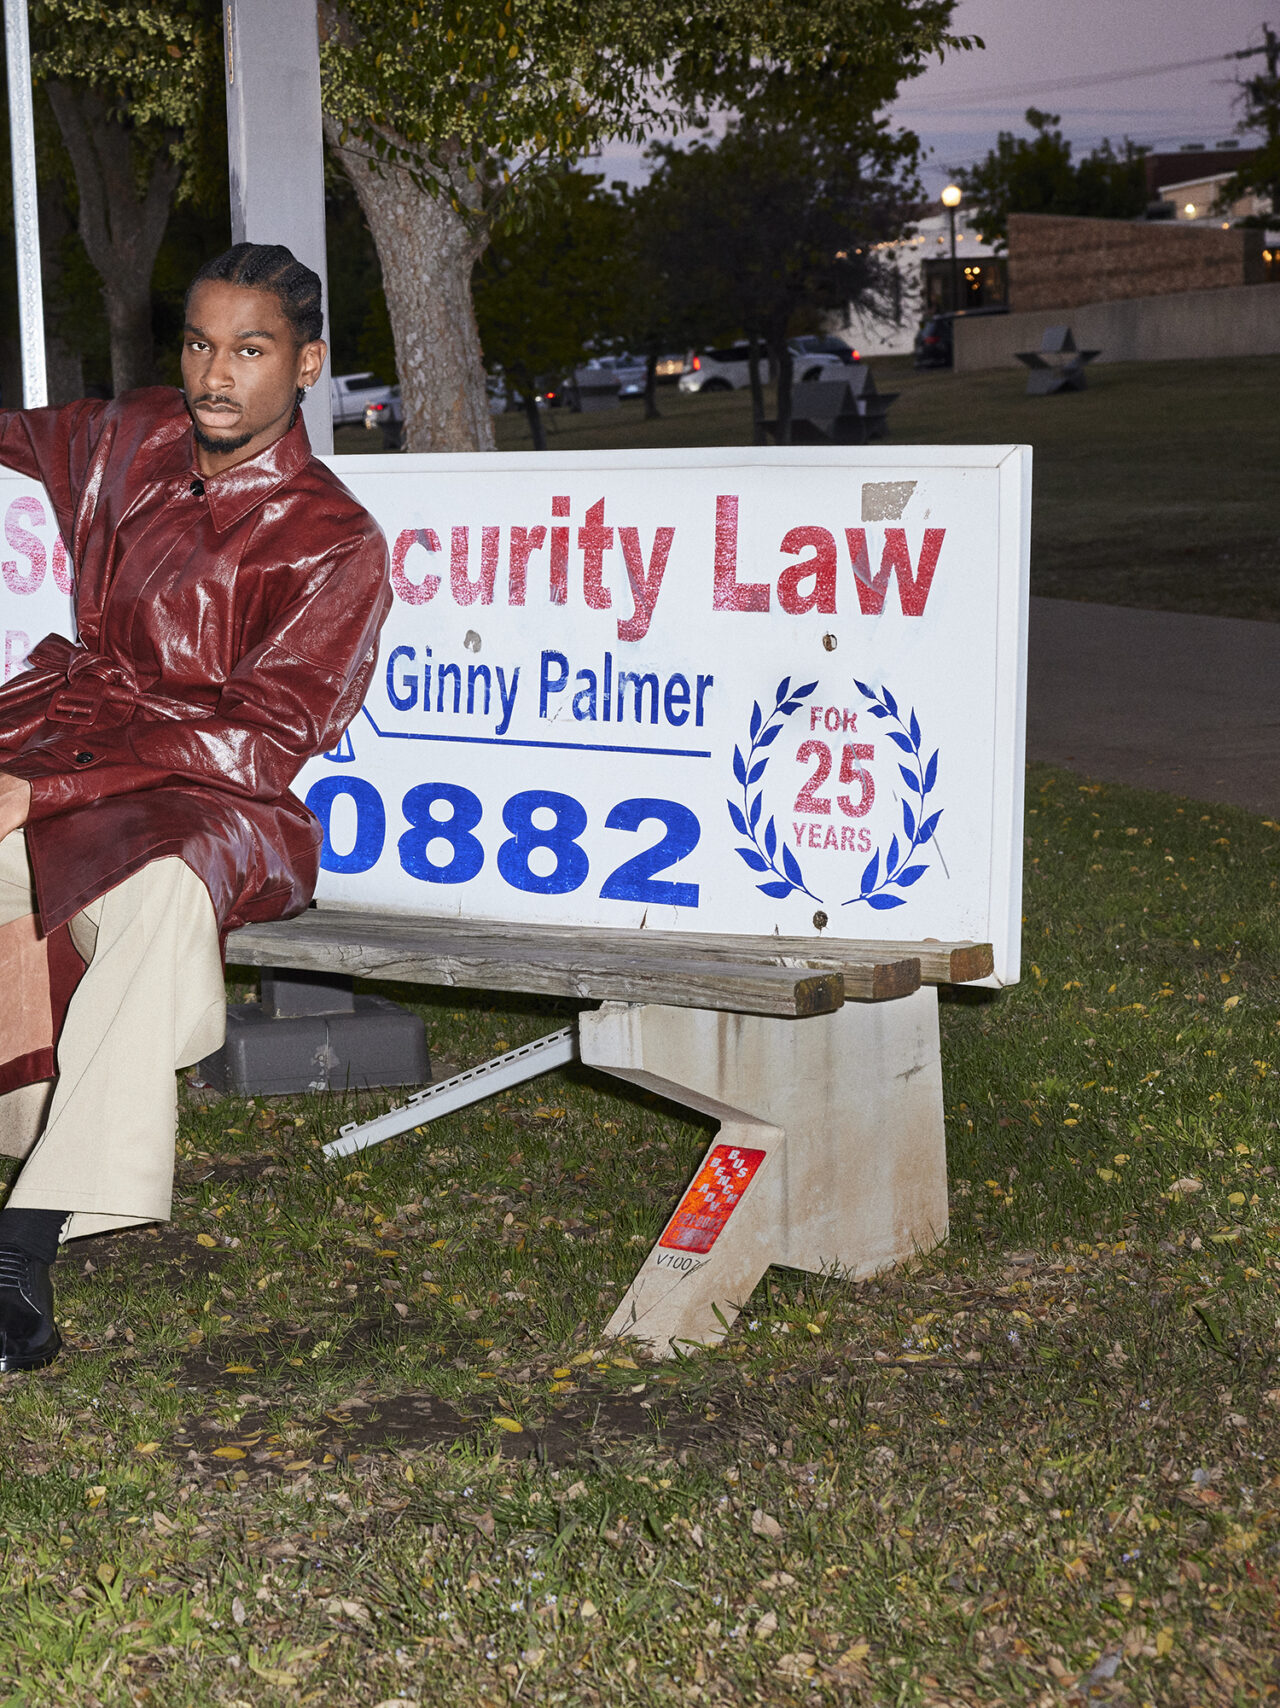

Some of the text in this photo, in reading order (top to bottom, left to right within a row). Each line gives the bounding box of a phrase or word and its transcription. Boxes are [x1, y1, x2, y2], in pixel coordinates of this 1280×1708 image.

[713, 494, 947, 617] Law
[386, 644, 714, 736] Ginny Palmer
[810, 706, 858, 733] FOR
[792, 739, 876, 818] 25
[304, 775, 702, 908] 0882
[792, 822, 872, 853] YEARS
[709, 1158, 738, 1204] BENCH
[728, 1149, 748, 1178] BUS
